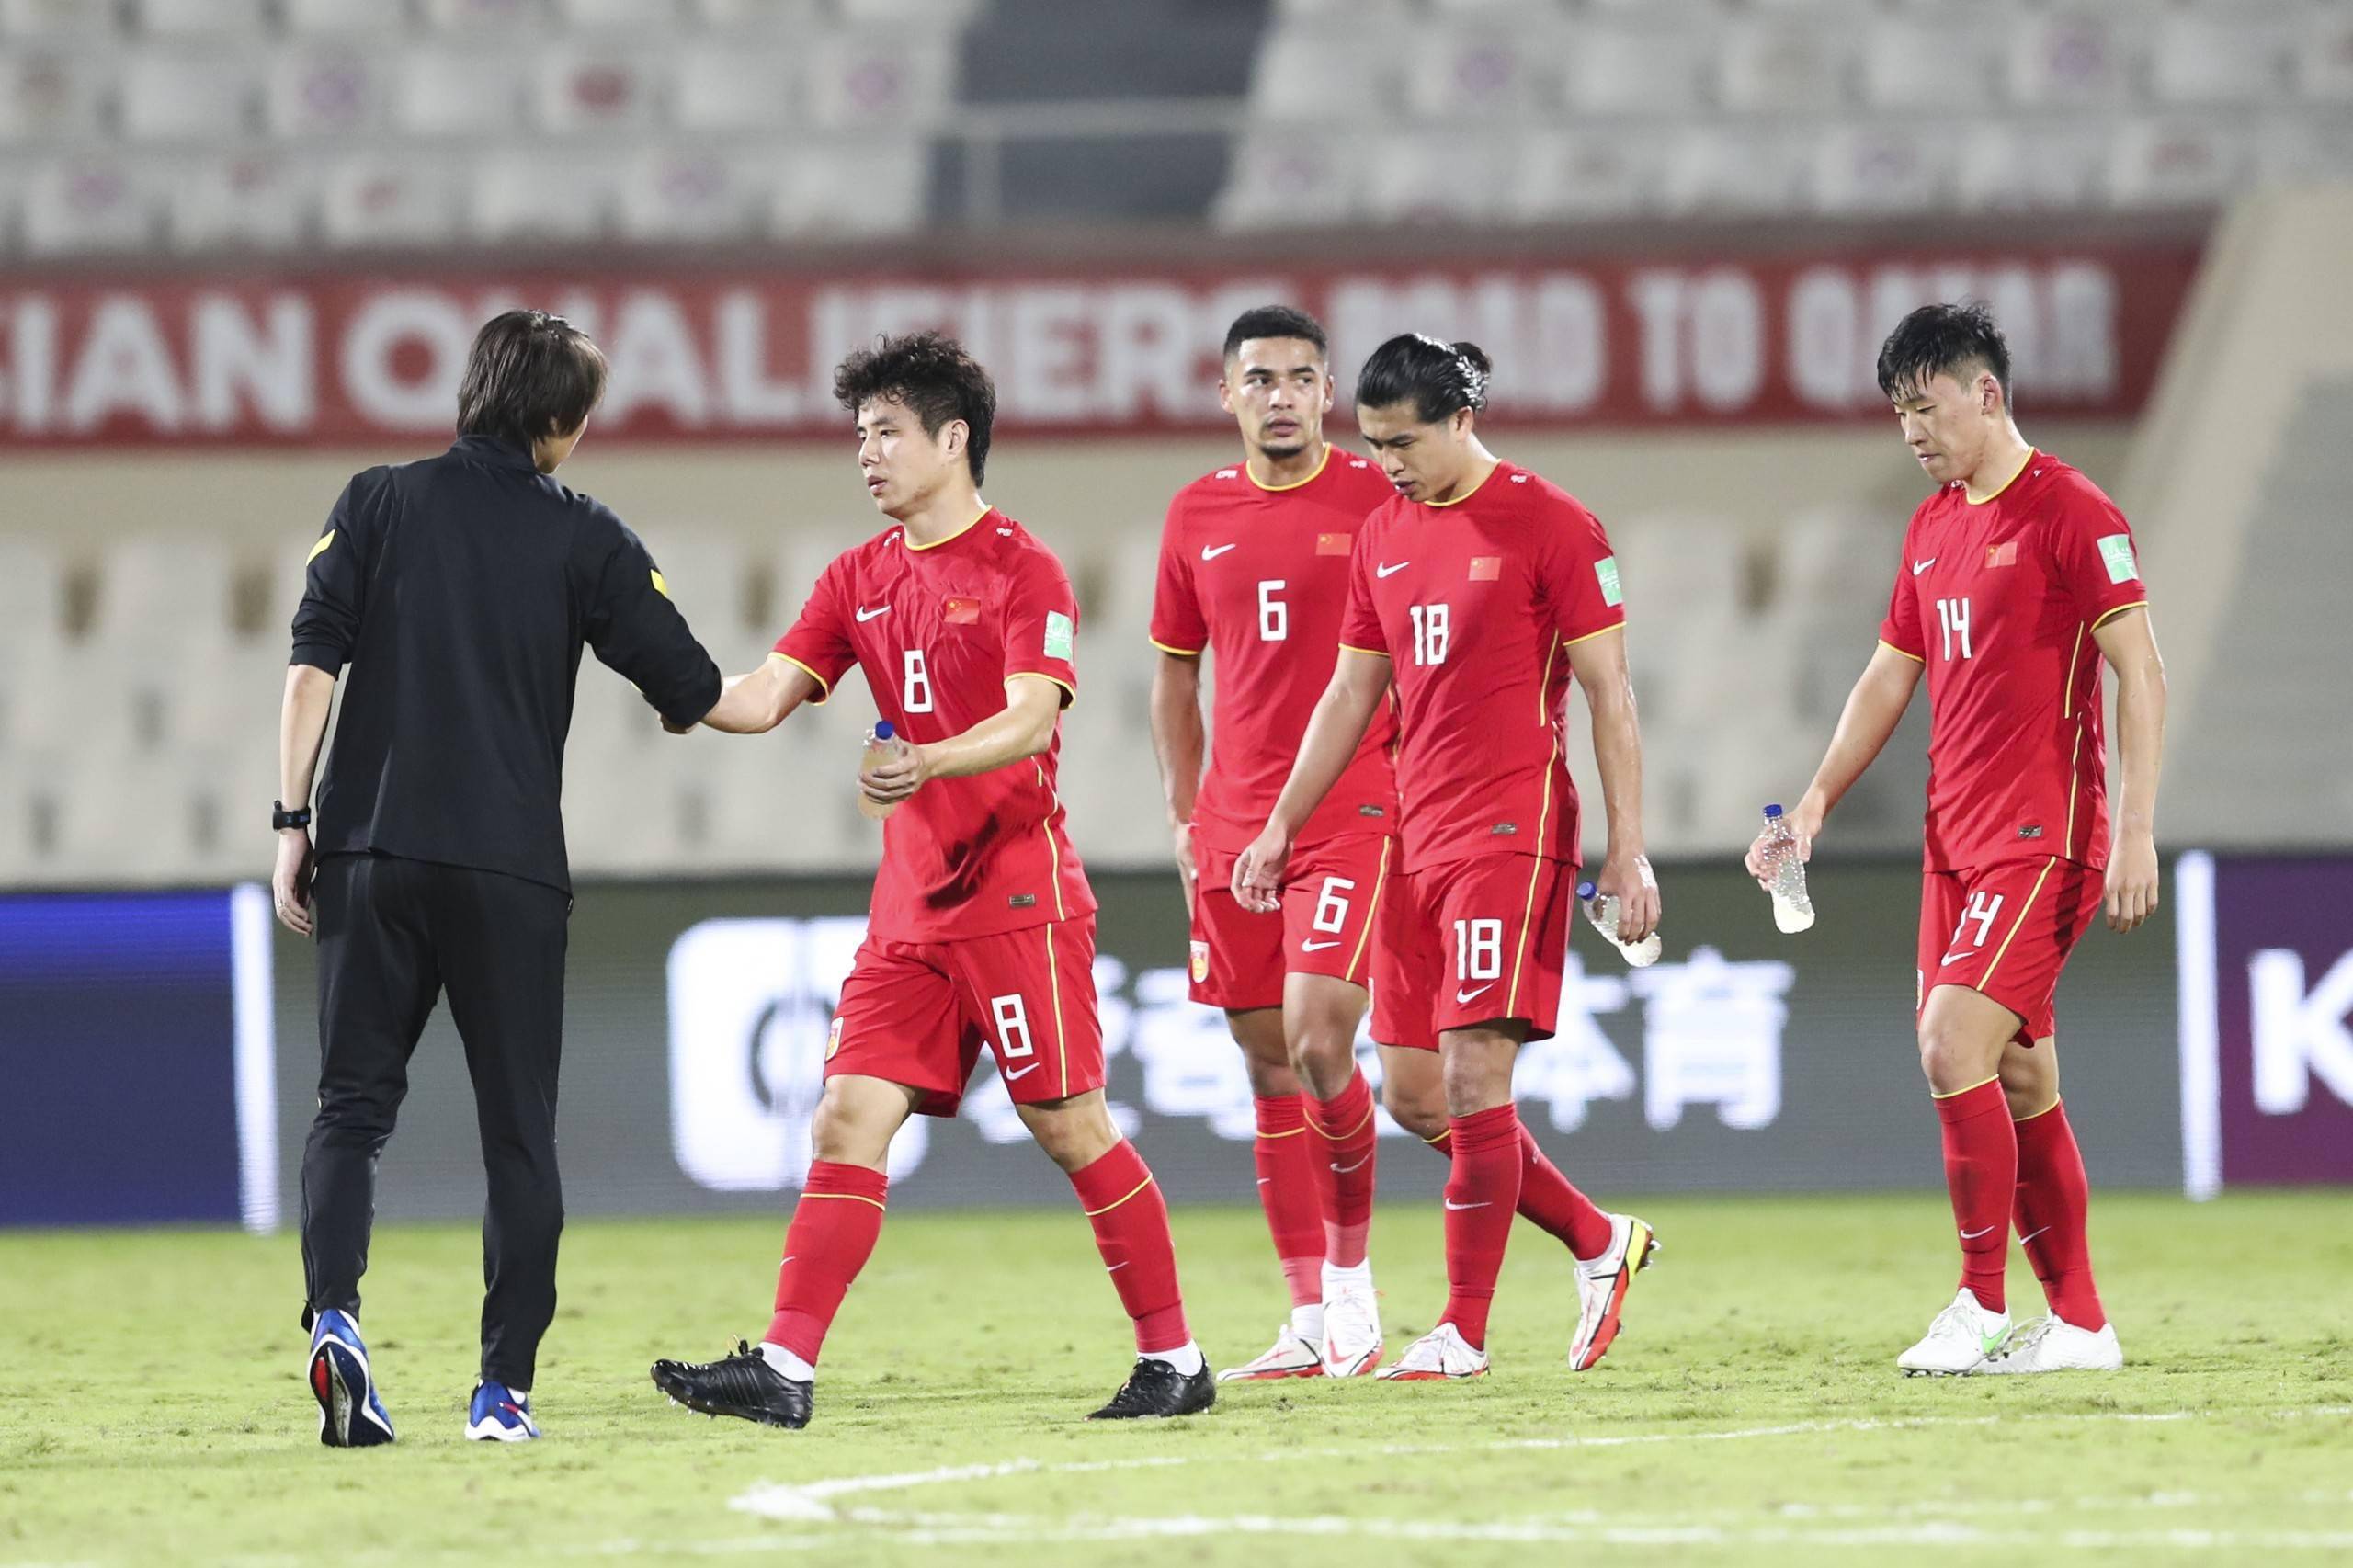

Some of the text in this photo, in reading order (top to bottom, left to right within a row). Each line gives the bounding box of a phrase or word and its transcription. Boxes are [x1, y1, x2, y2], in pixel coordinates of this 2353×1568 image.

[0, 290, 316, 433] IAN
[1629, 267, 1764, 409] TO
[1257, 579, 1288, 642] 6
[1409, 603, 1449, 666] 18
[1936, 597, 1972, 662] 14
[904, 649, 933, 713] 8
[1312, 876, 1355, 934] 6
[1453, 918, 1502, 981] 18
[991, 994, 1034, 1058] 8
